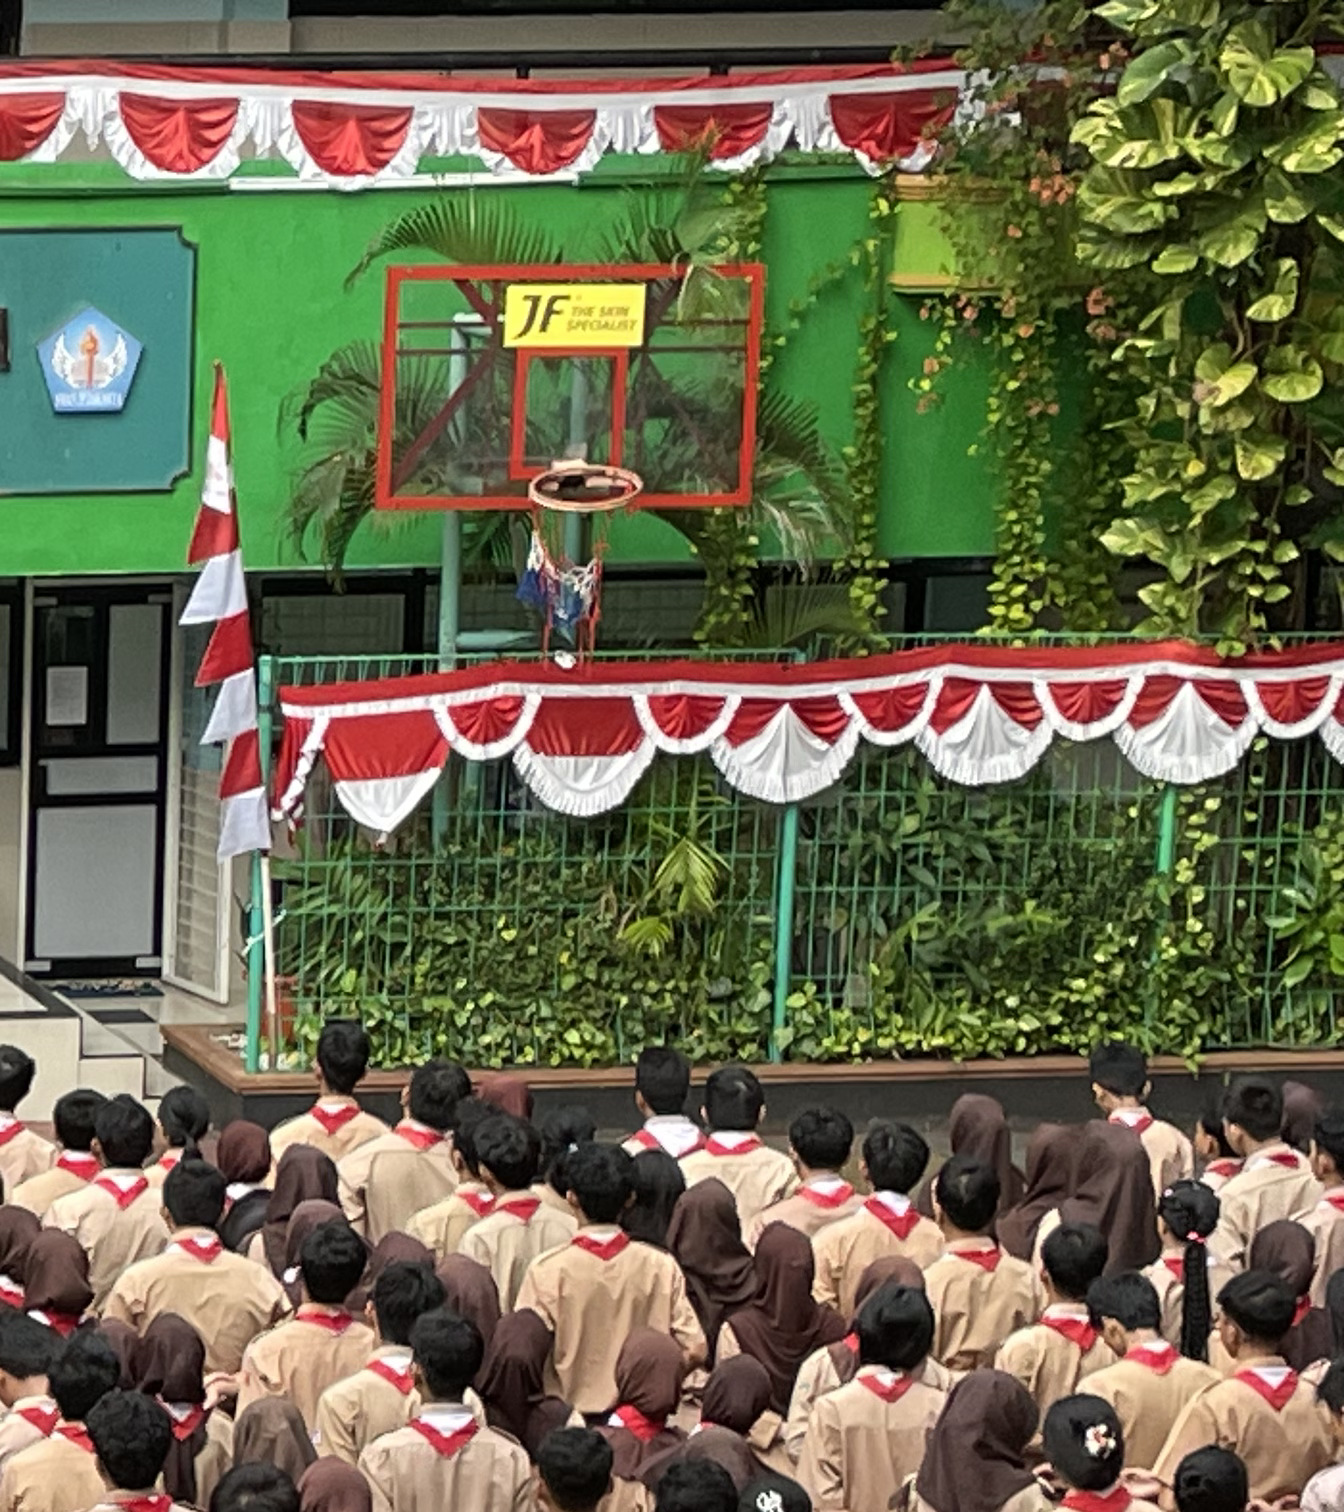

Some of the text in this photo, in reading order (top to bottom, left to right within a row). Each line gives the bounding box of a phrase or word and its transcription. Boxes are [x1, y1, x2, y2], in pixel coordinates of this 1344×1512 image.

[513, 294, 571, 340] JF
[571, 305, 595, 317] THE
[566, 318, 638, 333] SPECIALIST
